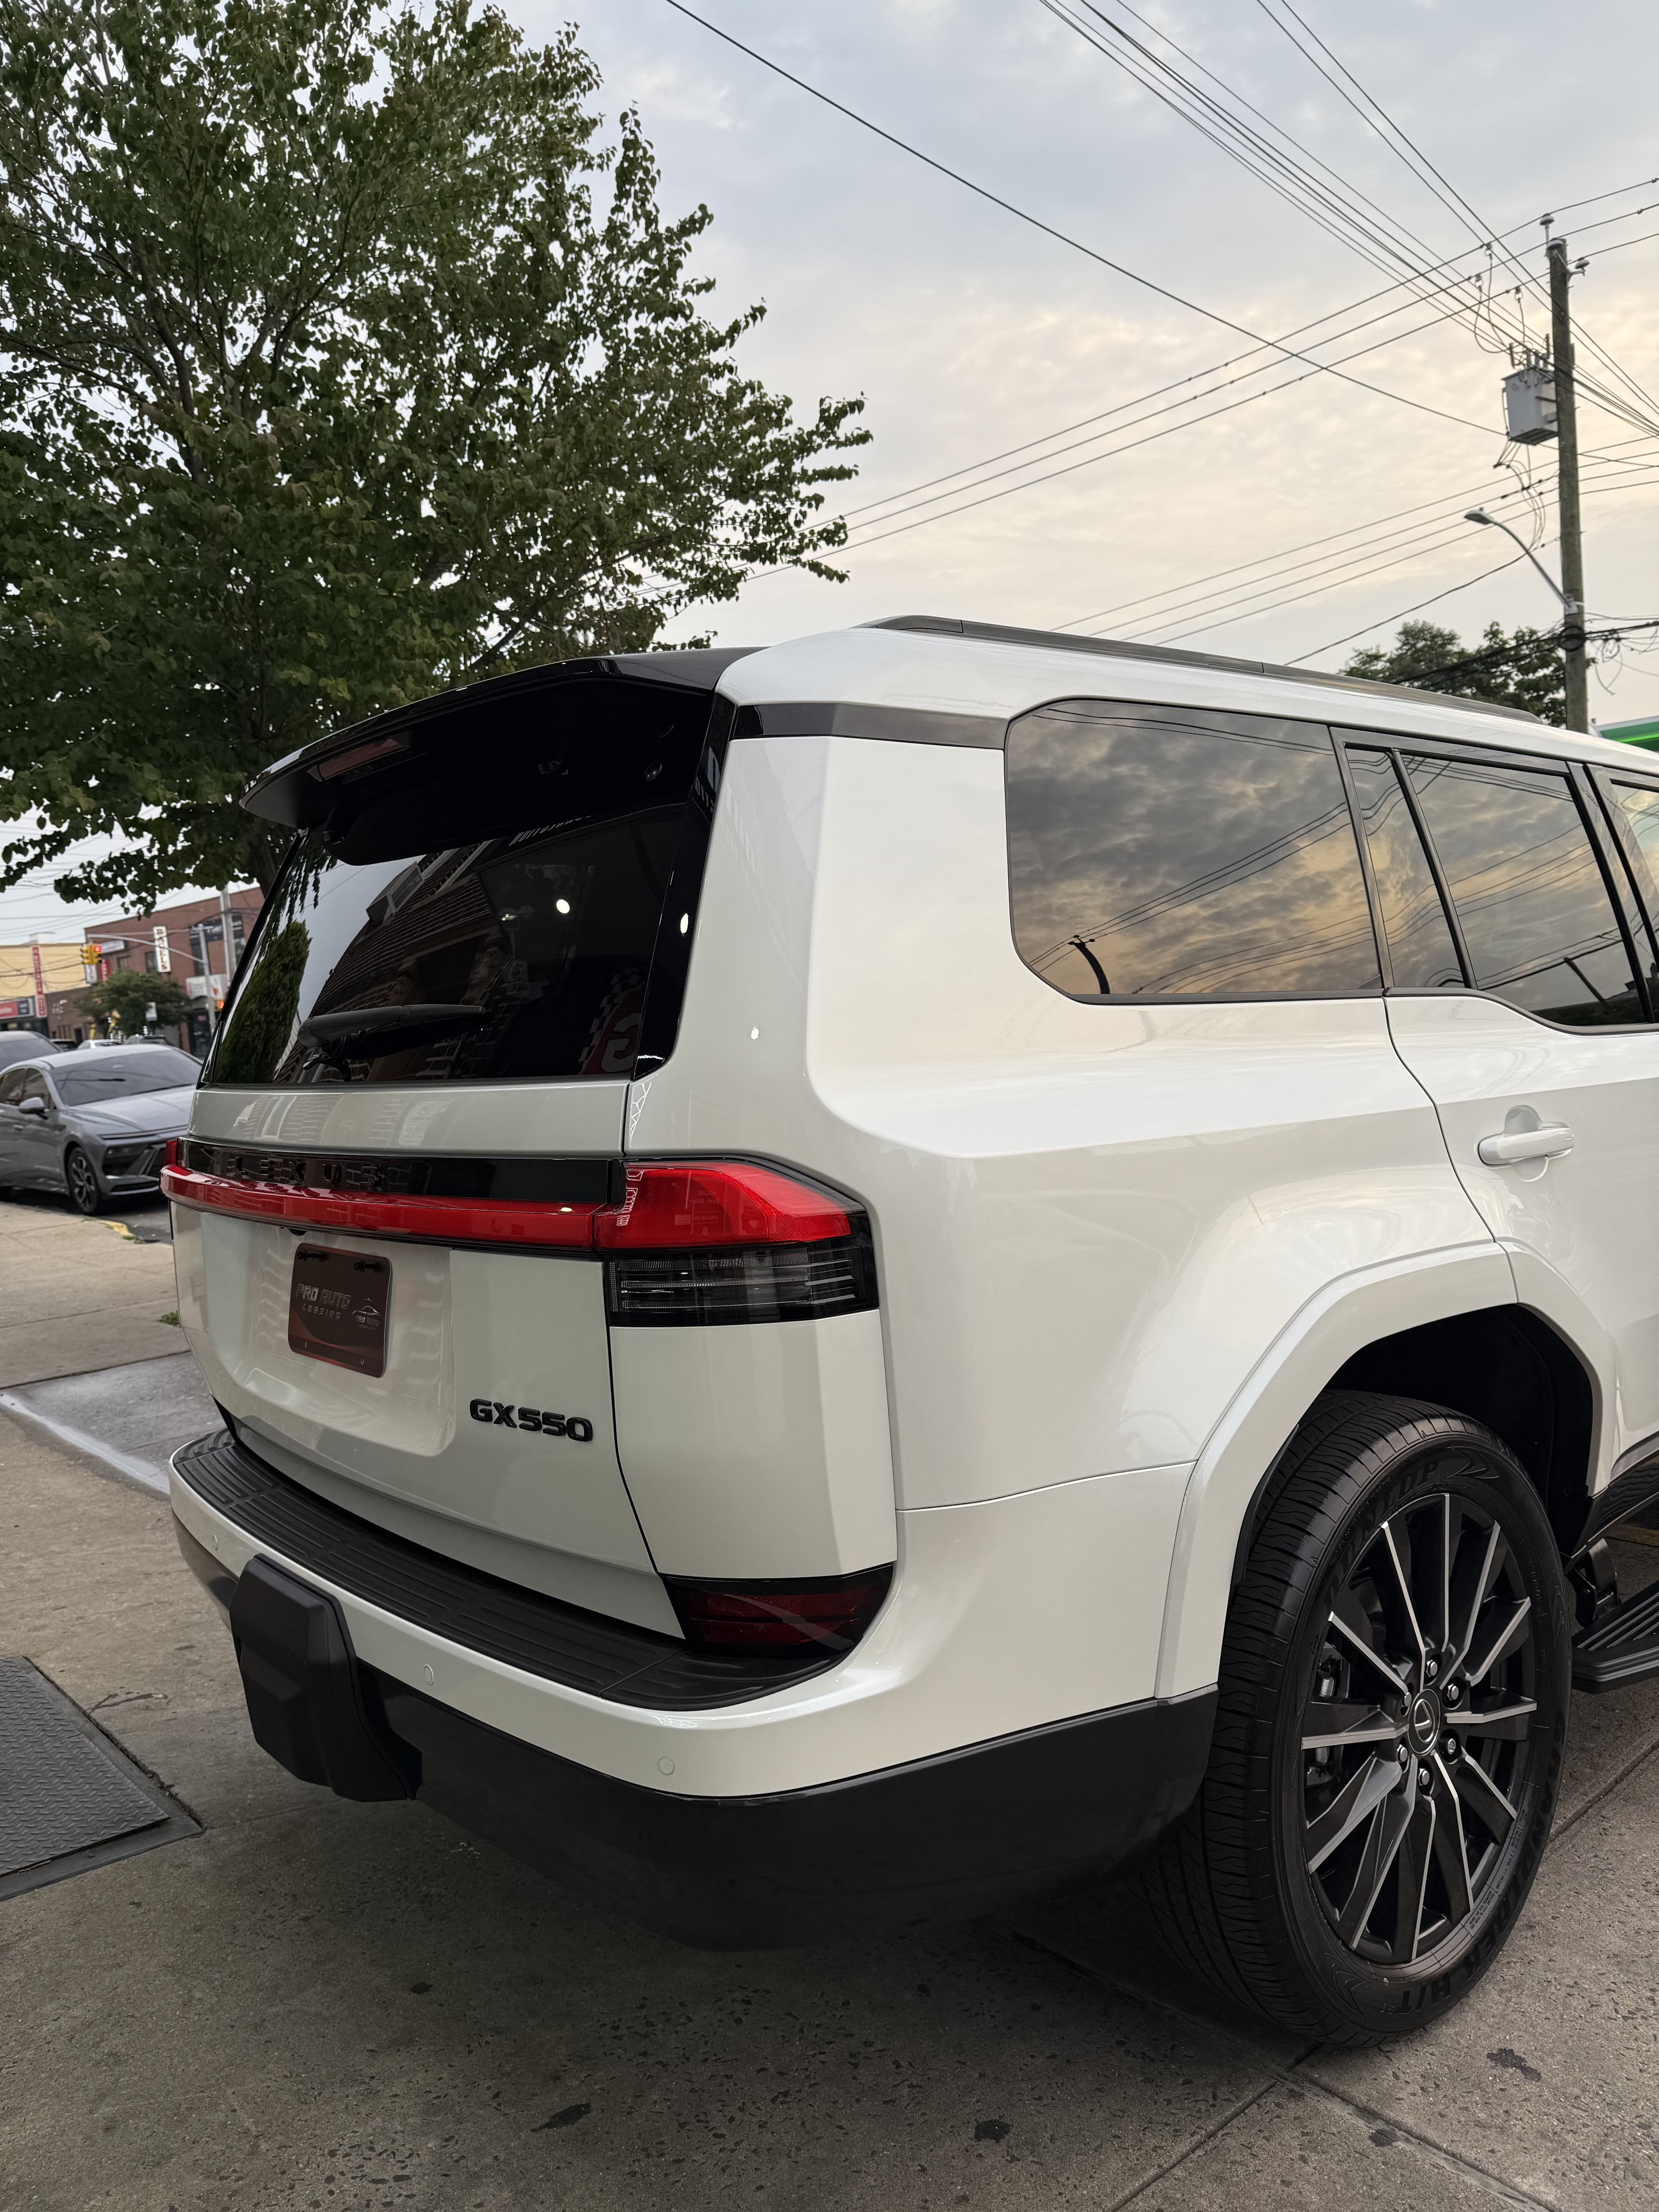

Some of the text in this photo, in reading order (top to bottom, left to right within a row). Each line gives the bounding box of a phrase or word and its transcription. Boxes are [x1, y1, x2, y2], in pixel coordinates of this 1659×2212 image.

[235, 1157, 380, 1185] LEXUS
[296, 1284, 352, 1310] PRO AUTO
[302, 1303, 341, 1319] LEASING
[469, 1398, 593, 1442] GX550
